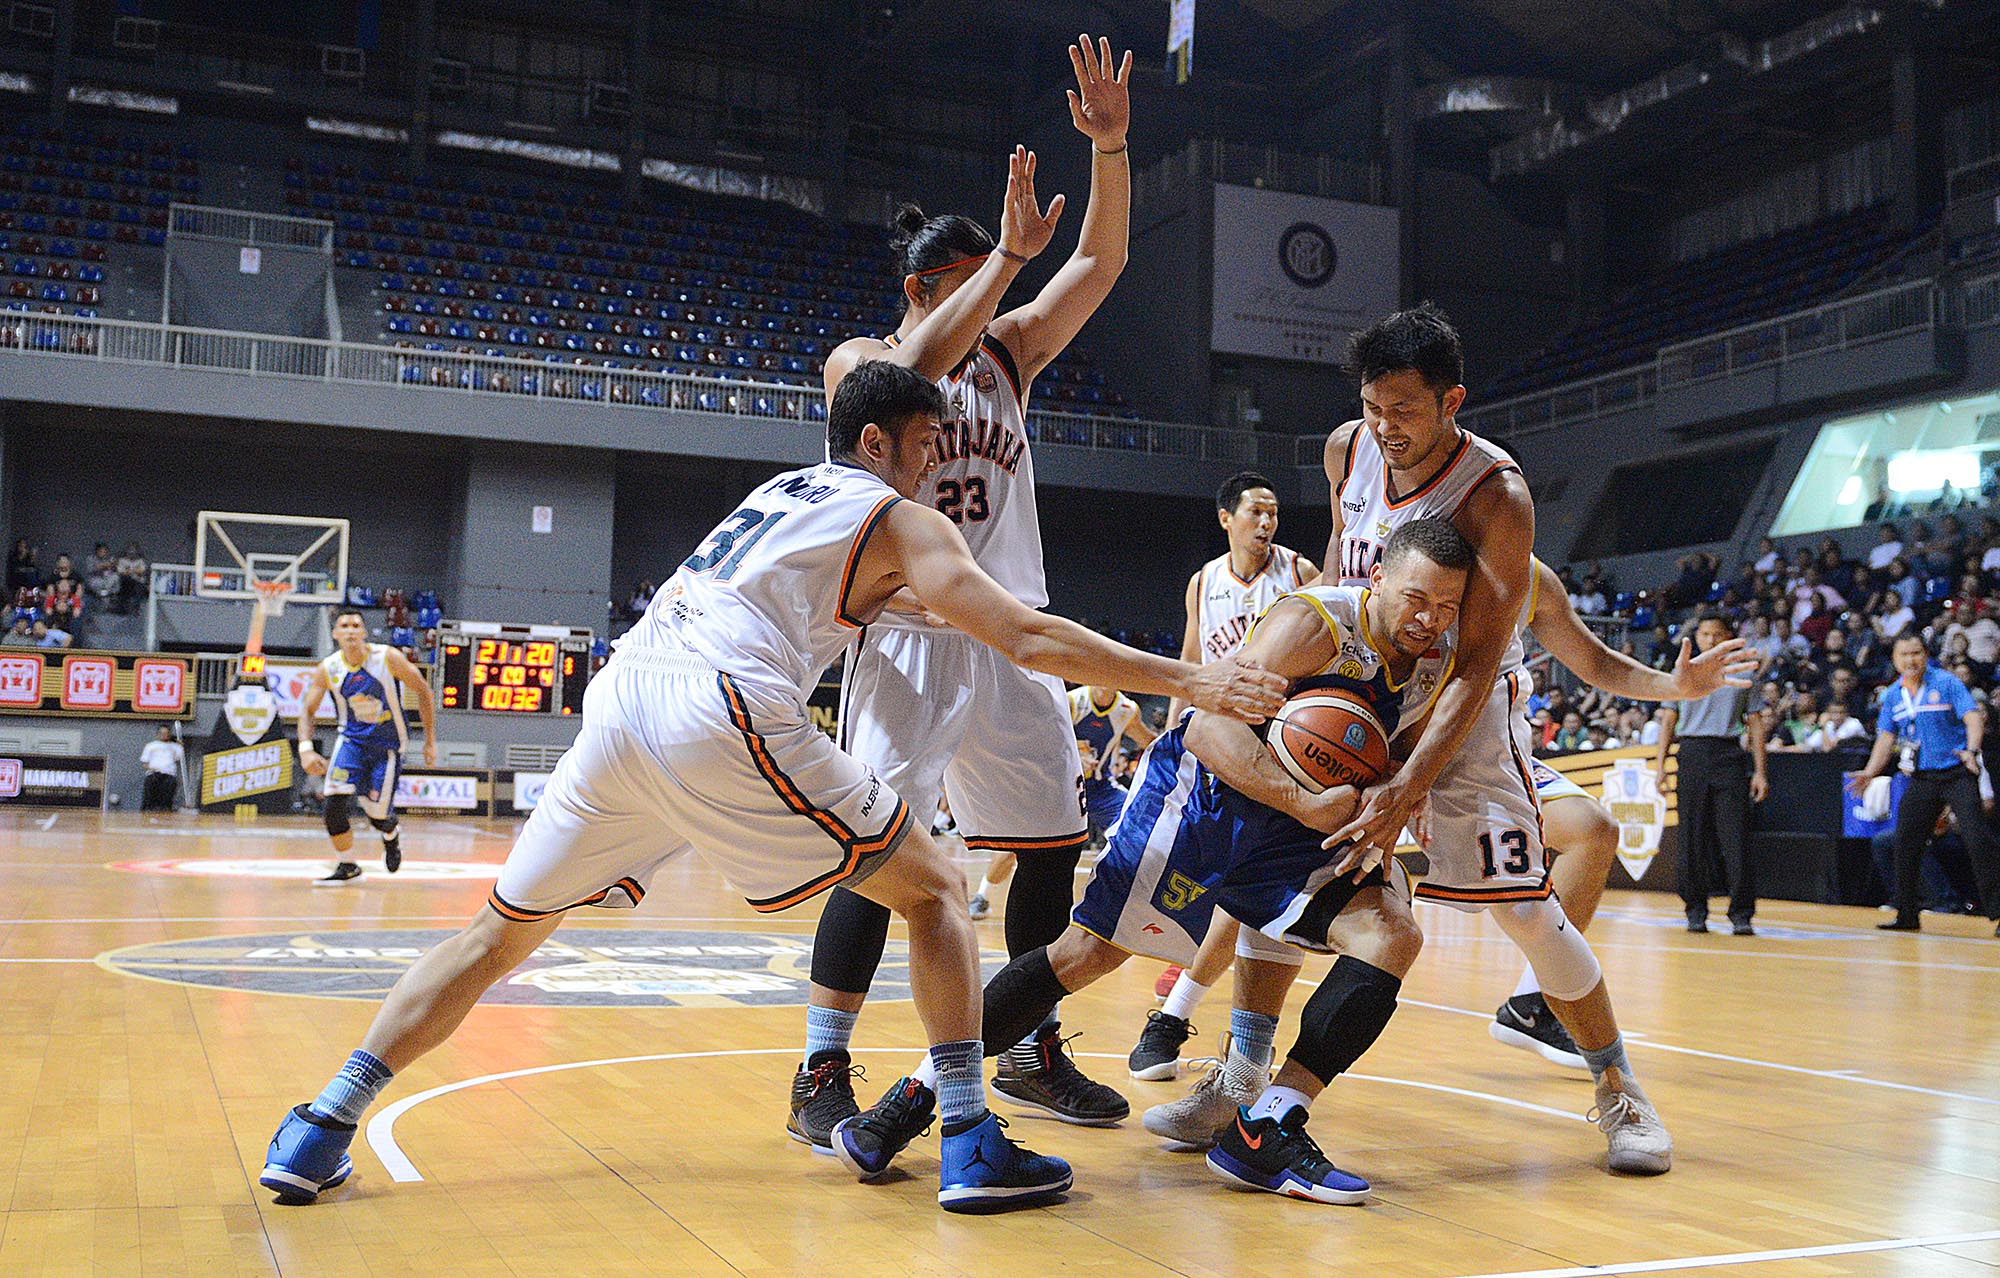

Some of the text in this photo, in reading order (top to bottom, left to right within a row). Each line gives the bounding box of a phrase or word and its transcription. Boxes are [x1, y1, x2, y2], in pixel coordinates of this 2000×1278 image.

[935, 474, 992, 527] 23
[682, 508, 792, 582] 31
[477, 640, 508, 664] 21
[525, 643, 556, 666] 20
[216, 745, 280, 775] PERBASI
[213, 766, 281, 797] CUP 2017
[1478, 826, 1532, 880] 13
